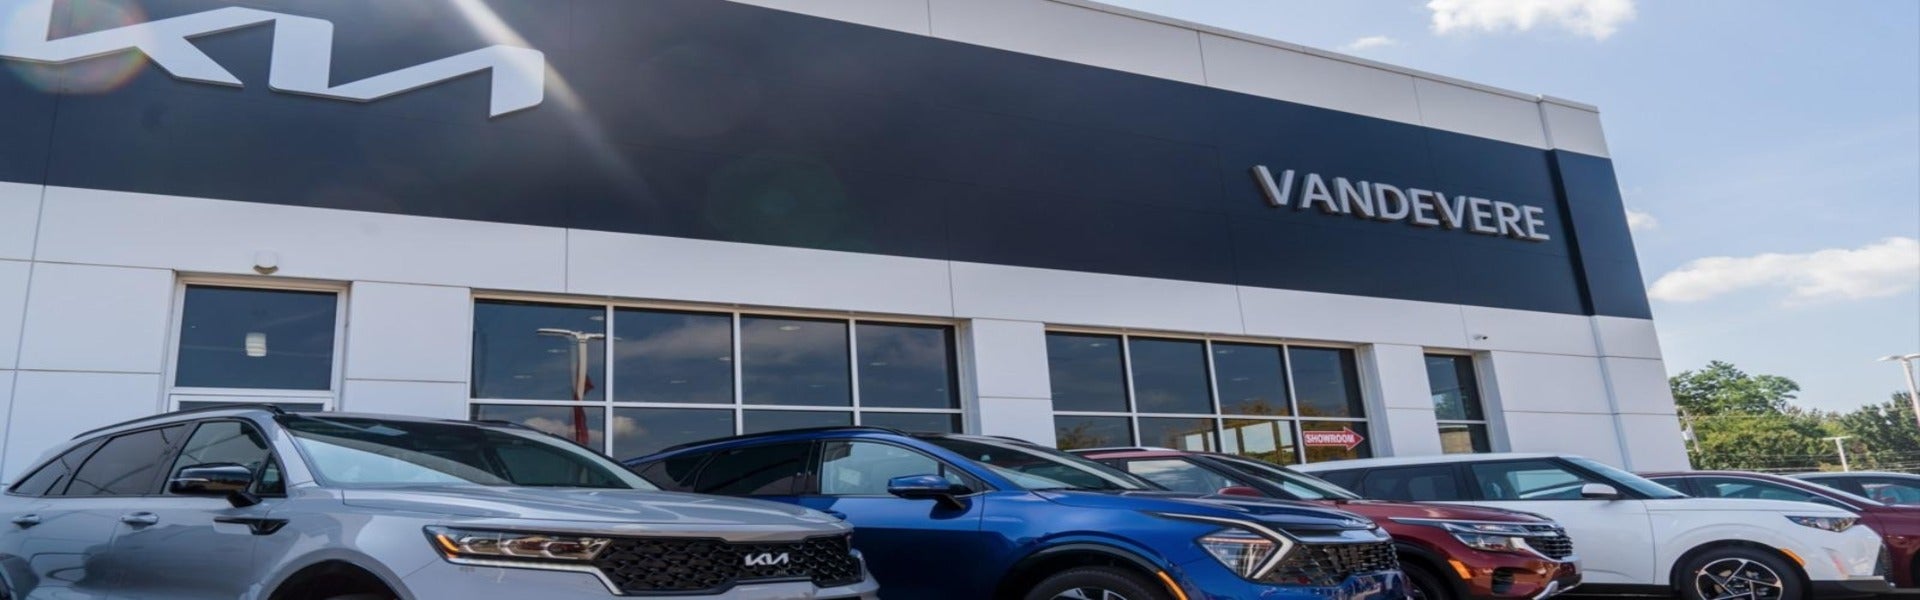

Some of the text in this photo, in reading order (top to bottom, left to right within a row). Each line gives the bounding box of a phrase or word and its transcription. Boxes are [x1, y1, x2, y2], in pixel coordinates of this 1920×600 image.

[1253, 165, 1550, 241] VANDEVERE
[1305, 433, 1355, 444] SHOWROOM
[745, 552, 789, 566] KIA
